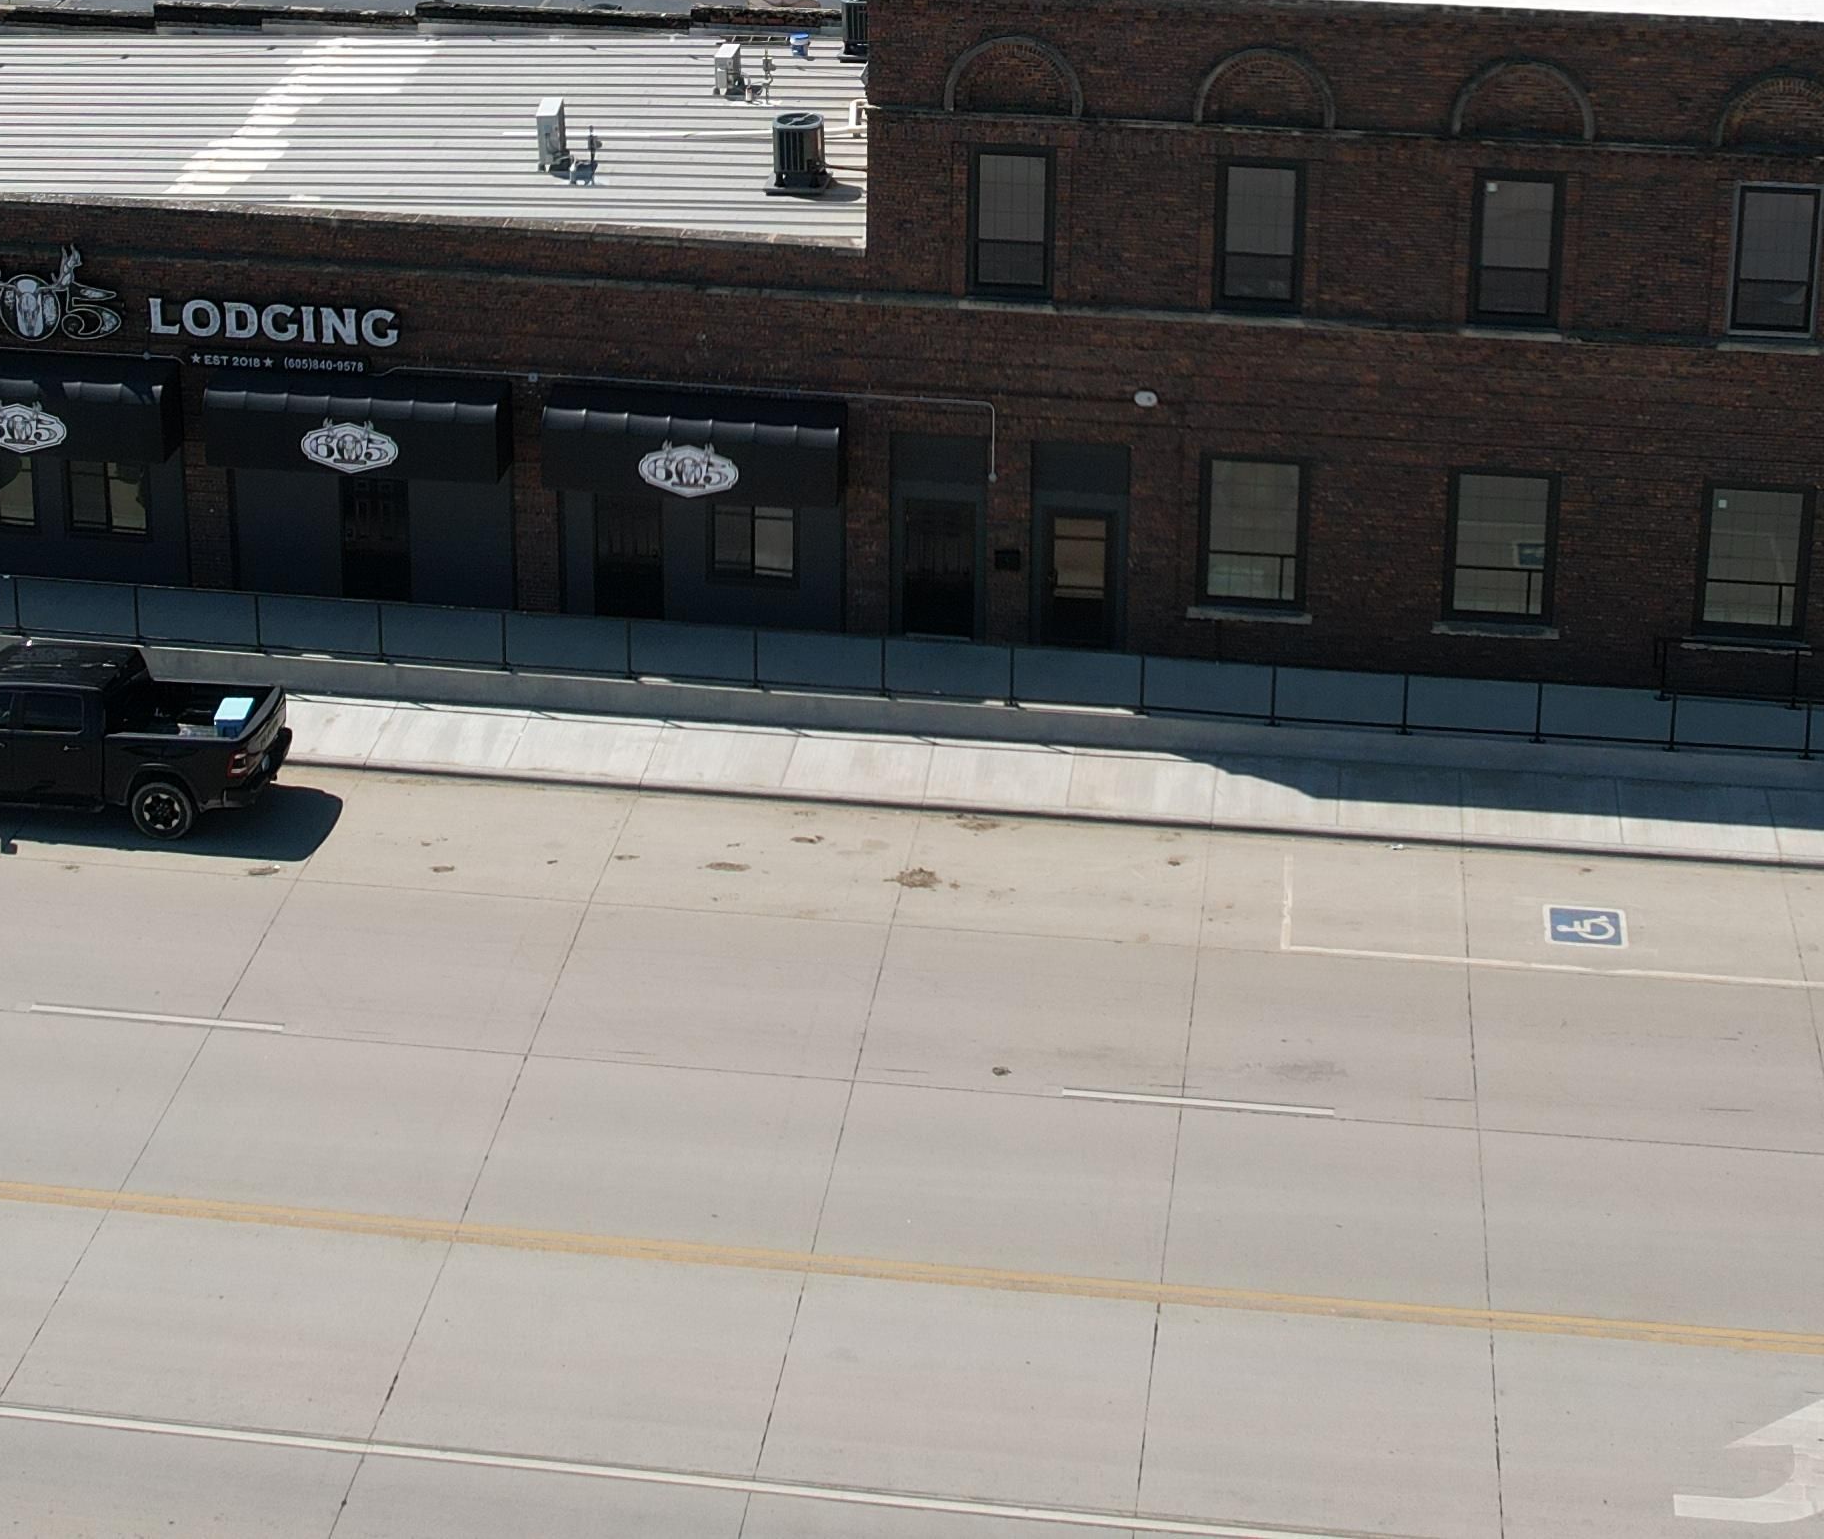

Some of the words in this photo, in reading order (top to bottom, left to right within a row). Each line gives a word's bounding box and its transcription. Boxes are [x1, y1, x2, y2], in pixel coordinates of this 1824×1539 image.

[147, 297, 400, 348] LODGING
[204, 355, 229, 366] EST
[232, 356, 261, 368] 2018
